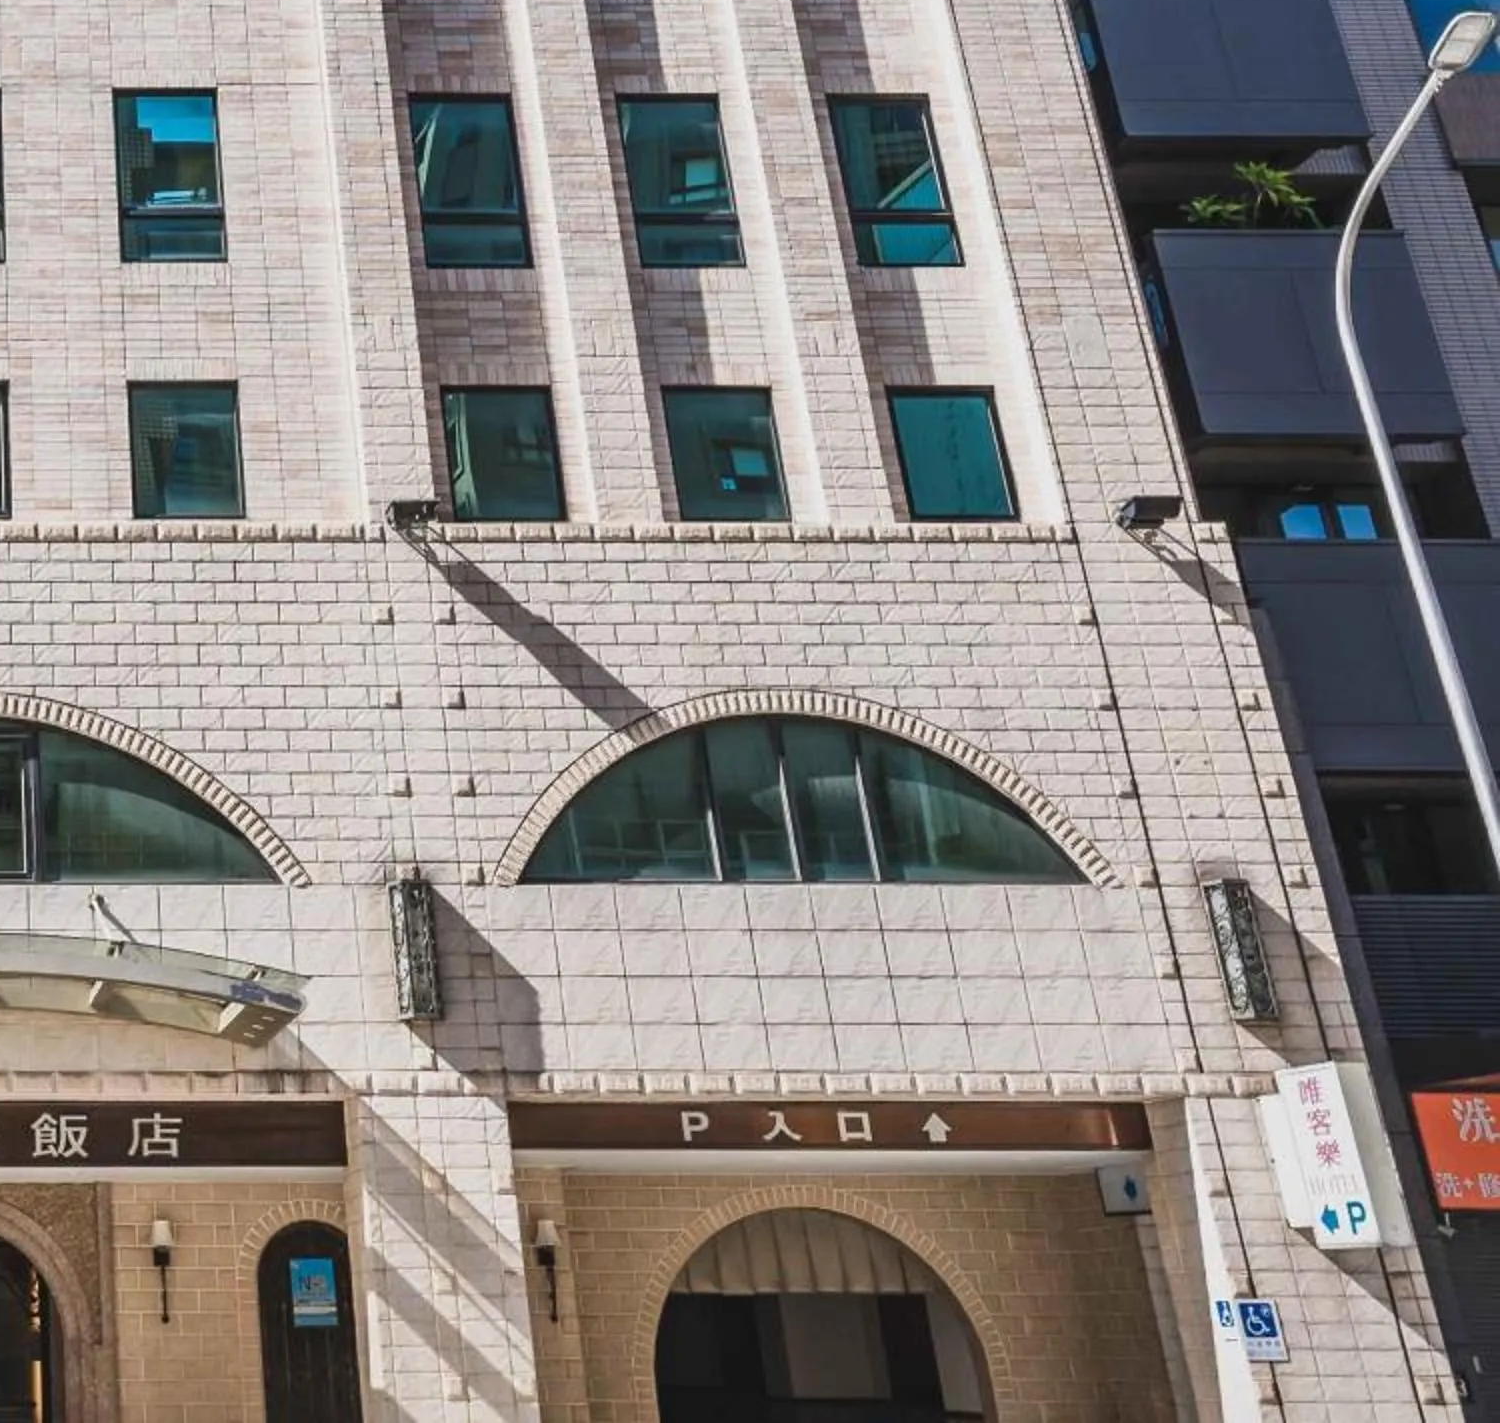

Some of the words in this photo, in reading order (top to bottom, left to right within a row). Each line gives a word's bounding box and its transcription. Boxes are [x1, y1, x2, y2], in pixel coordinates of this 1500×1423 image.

[681, 1111, 709, 1142] P
[763, 1111, 874, 1143] 入口
[1298, 1075, 1342, 1168] 唯客樂
[1346, 1200, 1367, 1235] P
